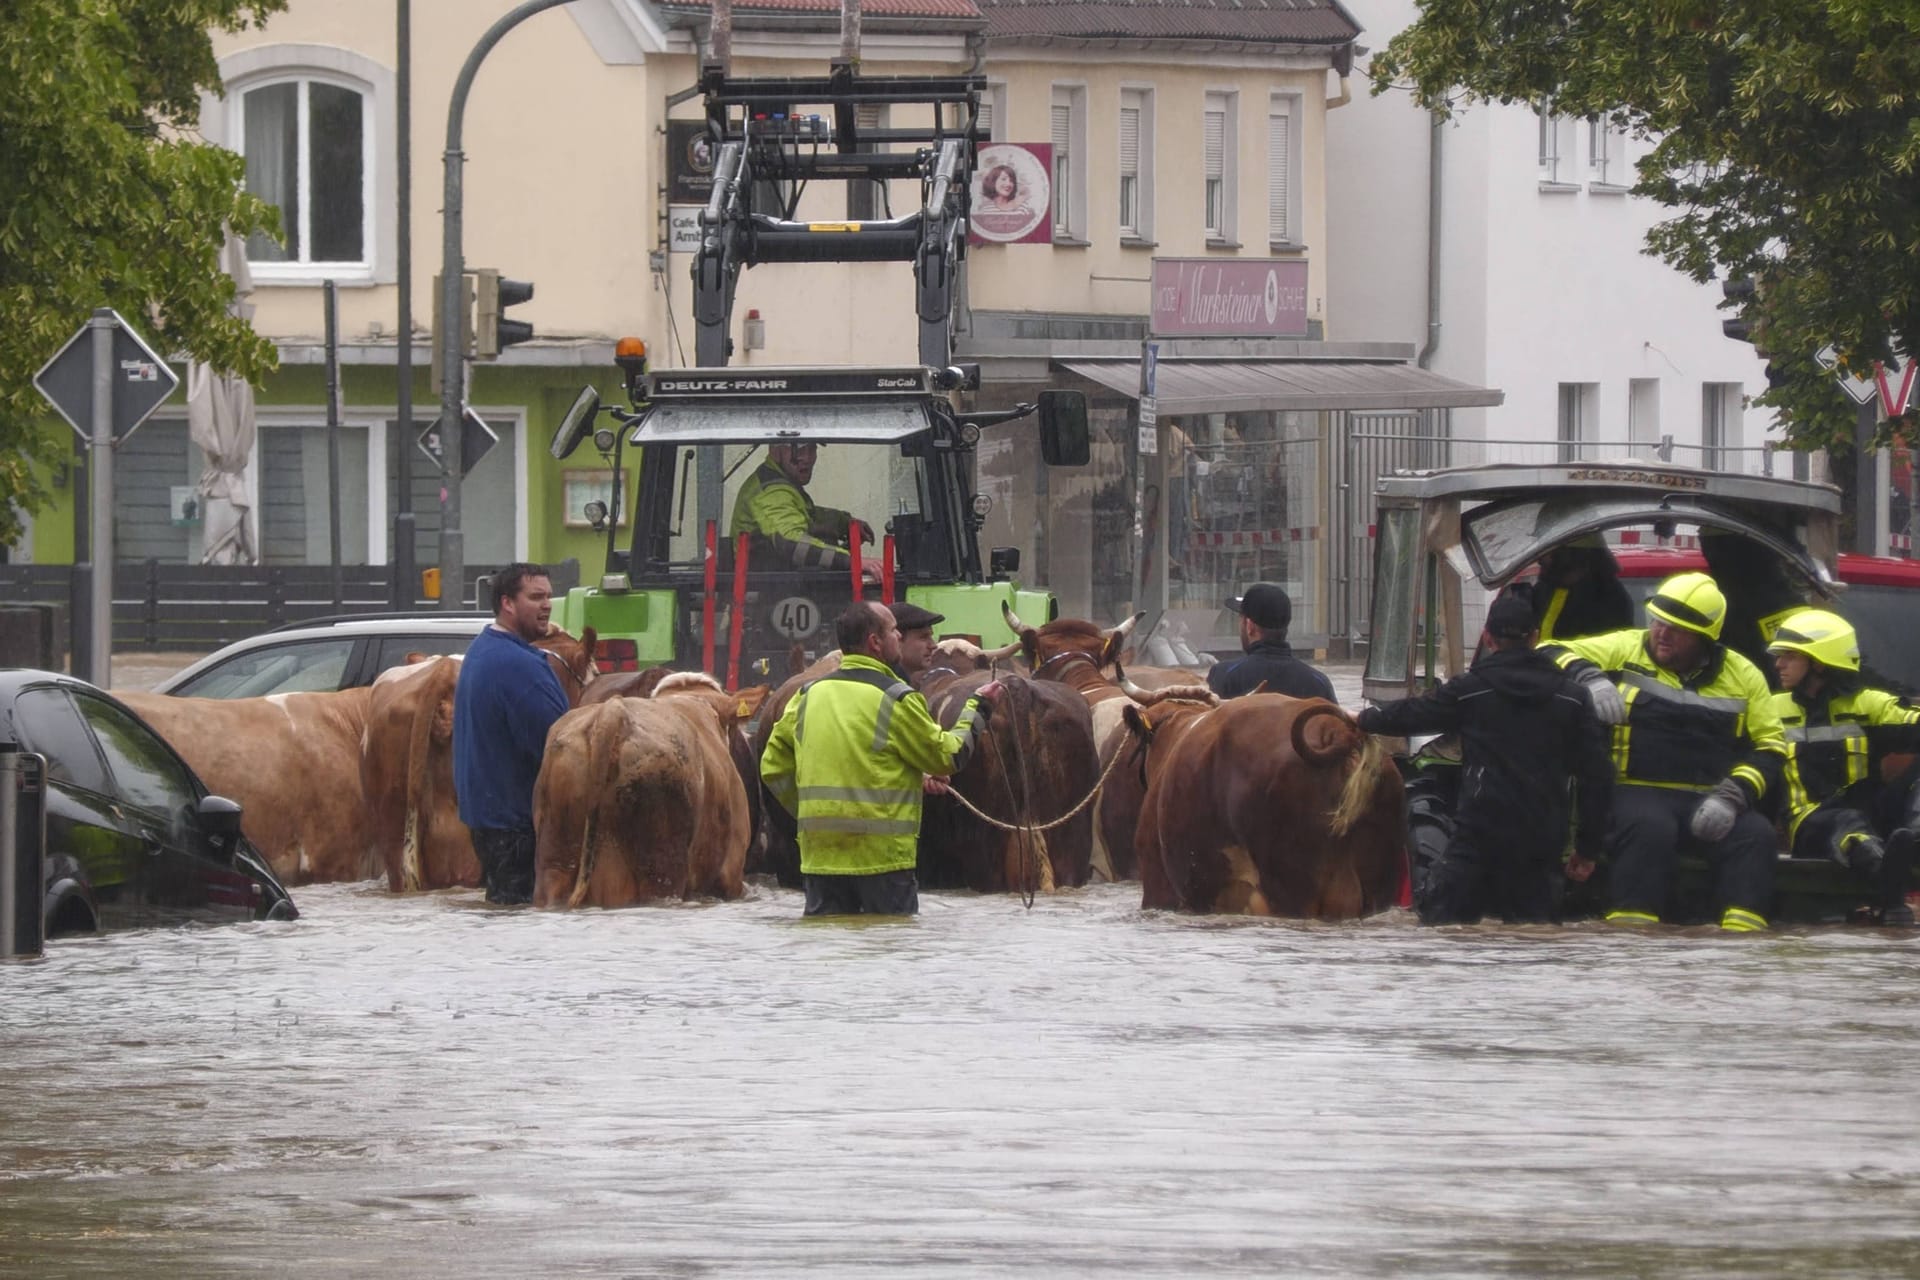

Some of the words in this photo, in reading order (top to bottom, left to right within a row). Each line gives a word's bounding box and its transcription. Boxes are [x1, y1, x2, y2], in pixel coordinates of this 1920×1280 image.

[1182, 265, 1263, 325] Marksteiner
[877, 377, 916, 387] StarCab
[781, 604, 809, 631] 40
